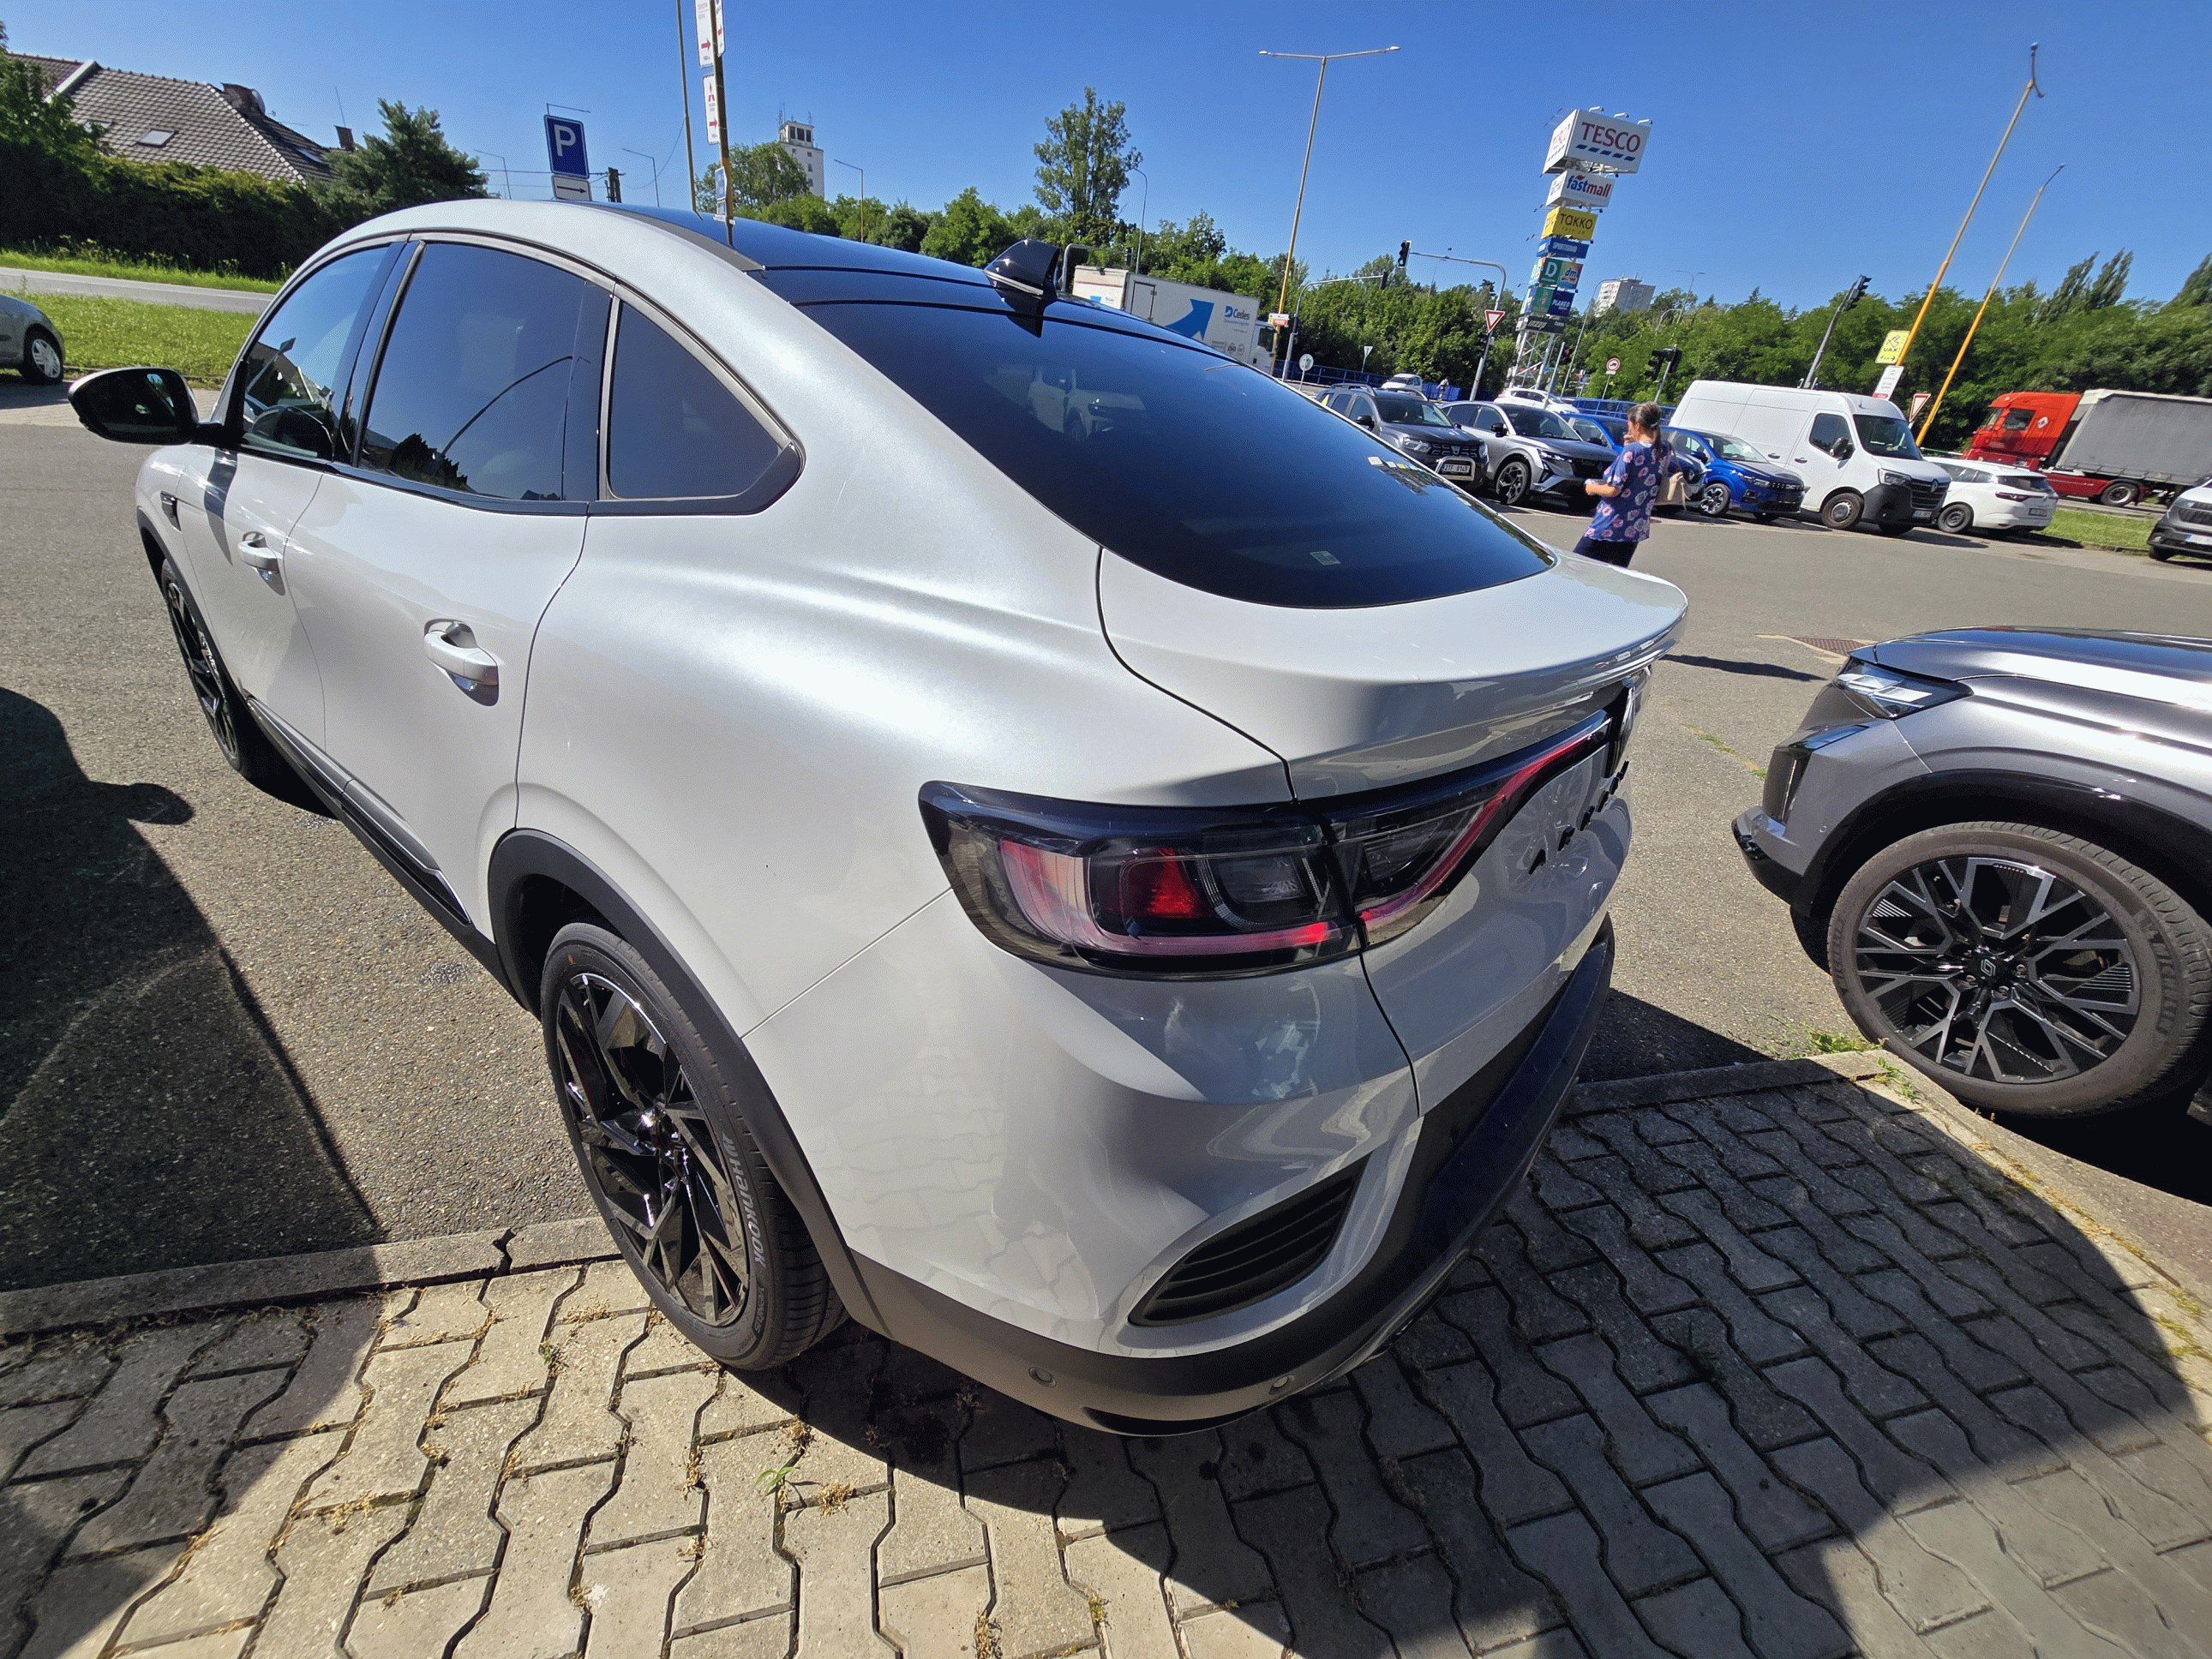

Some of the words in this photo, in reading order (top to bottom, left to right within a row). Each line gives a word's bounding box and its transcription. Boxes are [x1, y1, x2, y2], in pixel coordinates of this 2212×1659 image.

[553, 123, 577, 157] P
[1581, 122, 1641, 153] TESCO
[1566, 175, 1612, 197] fastmall
[1565, 267, 1578, 278] dm
